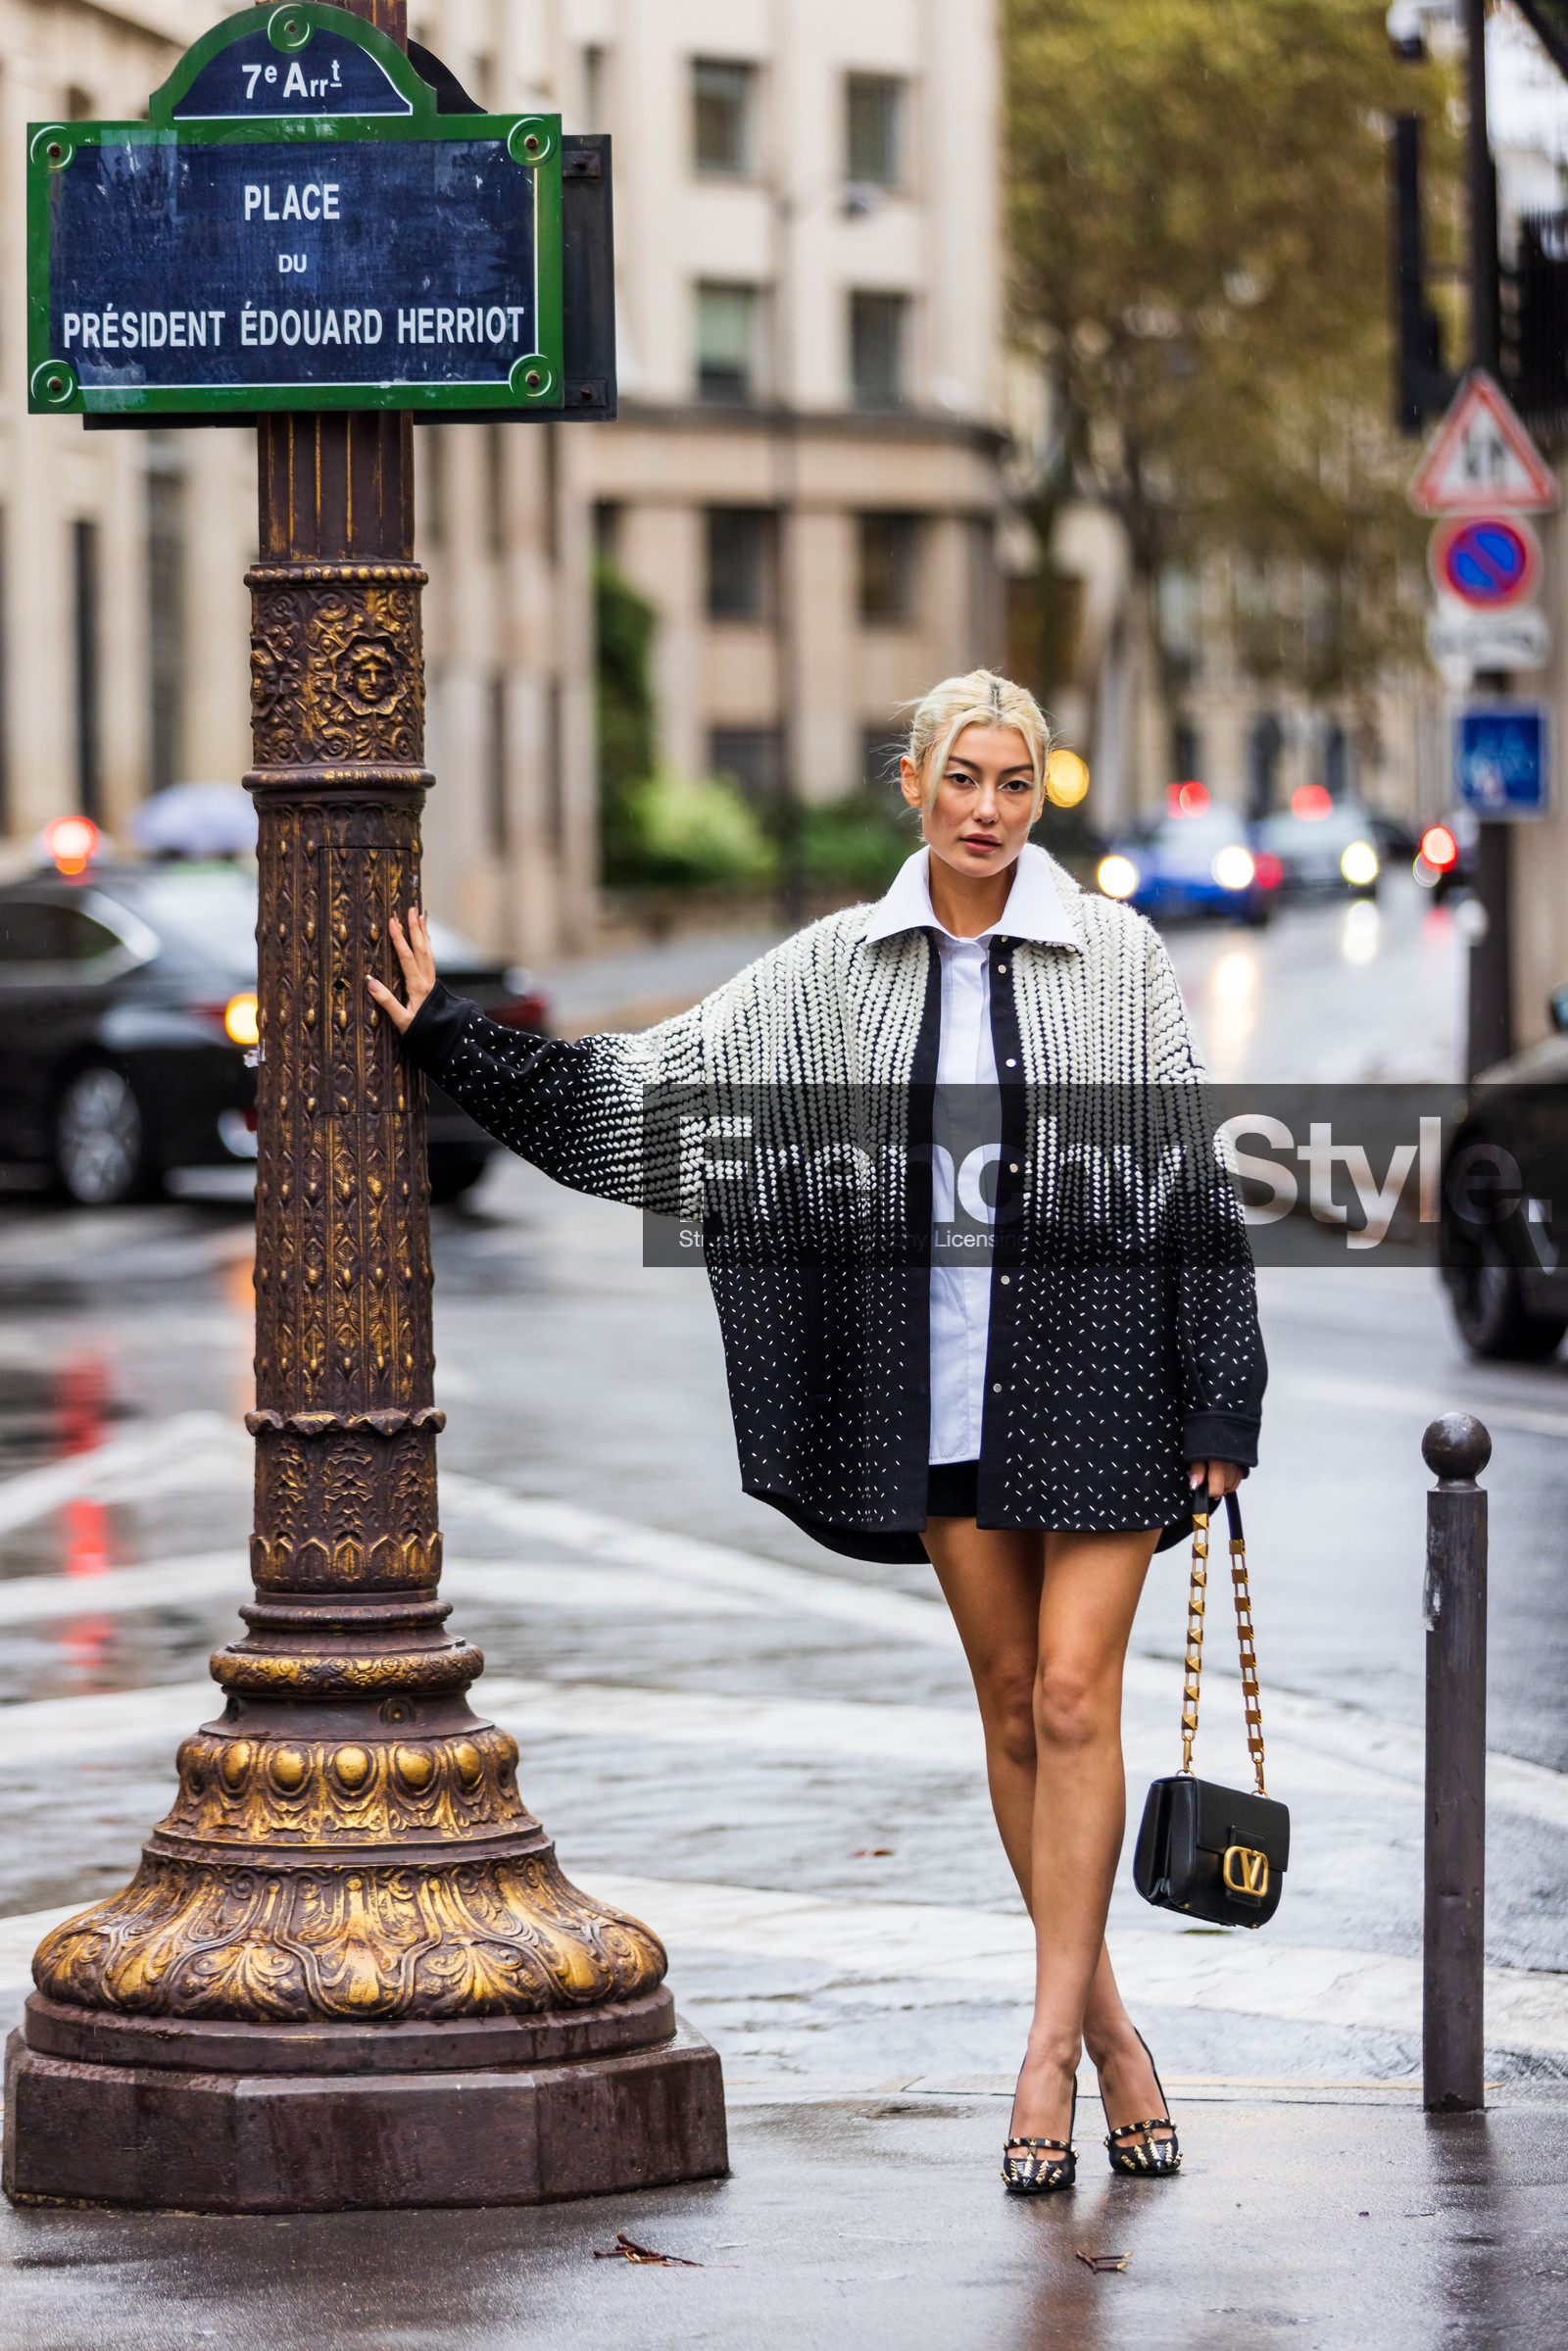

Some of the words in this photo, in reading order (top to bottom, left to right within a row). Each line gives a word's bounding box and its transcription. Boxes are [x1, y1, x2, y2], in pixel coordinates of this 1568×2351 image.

[244, 183, 341, 220] PLACE
[277, 254, 308, 273] DU
[63, 303, 226, 349] PRÉSIDENT
[240, 301, 383, 346] ÉDOUARD
[397, 306, 525, 344] HERRIOT
